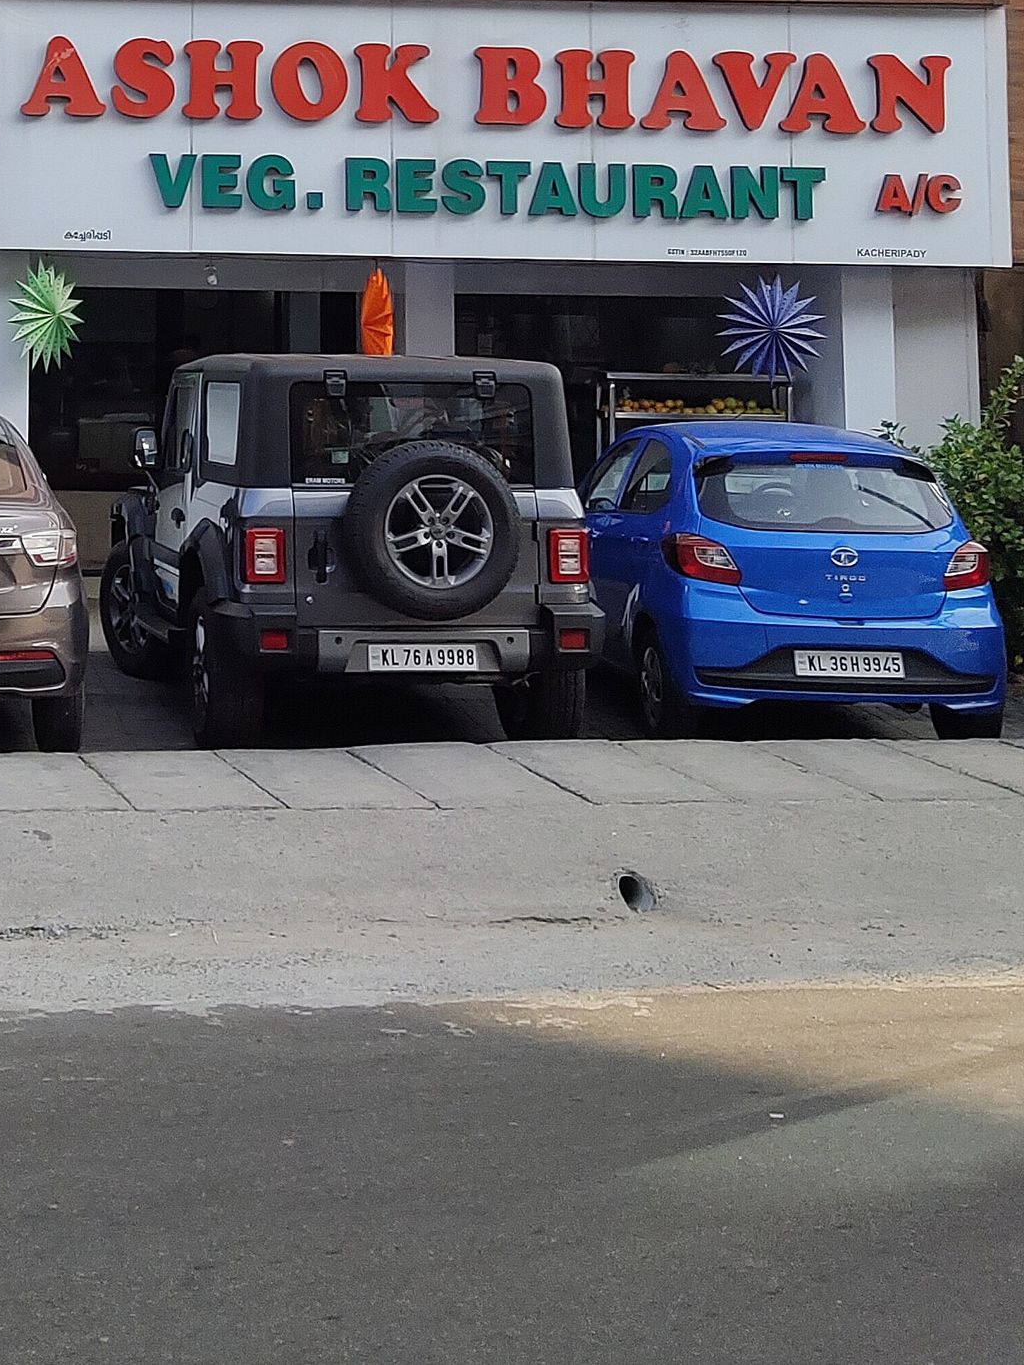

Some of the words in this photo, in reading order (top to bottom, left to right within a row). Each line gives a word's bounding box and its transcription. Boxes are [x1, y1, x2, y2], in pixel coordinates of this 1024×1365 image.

[20, 36, 440, 123] ASHOK
[473, 46, 952, 134] BHAVAN
[148, 153, 324, 210] VEG.
[344, 156, 826, 220] RESTAURANT
[875, 173, 963, 216] A/C
[856, 248, 927, 258] KACHERIPADY
[381, 648, 399, 666] KL
[403, 648, 421, 666] 76
[426, 648, 433, 666] A
[437, 648, 475, 666] 9988
[807, 655, 827, 672] KL
[830, 656, 848, 672] 36
[850, 656, 860, 672] H
[862, 656, 901, 673] 9945
